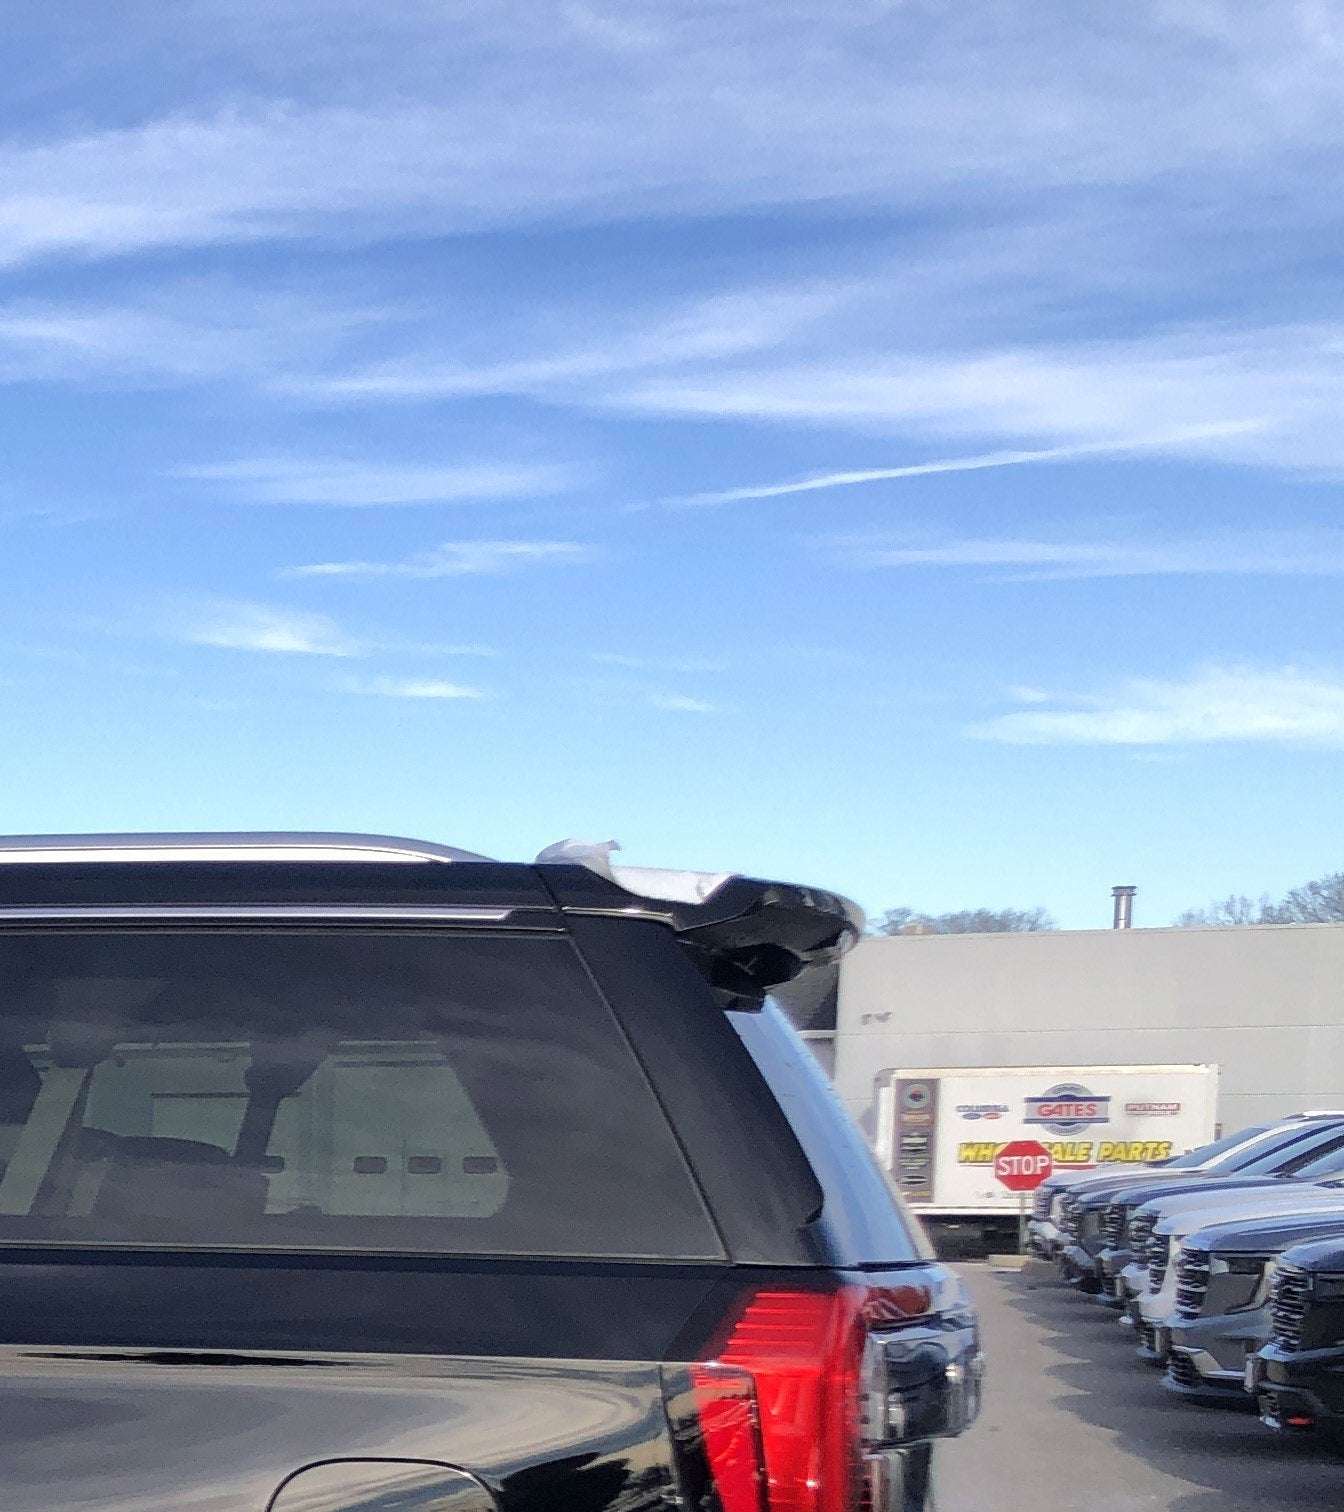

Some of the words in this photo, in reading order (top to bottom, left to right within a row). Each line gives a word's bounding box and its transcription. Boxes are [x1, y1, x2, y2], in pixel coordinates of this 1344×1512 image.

[1037, 1103, 1098, 1117] GATES
[958, 1141, 1093, 1164] WHALE
[1097, 1141, 1172, 1163] PARTS
[997, 1155, 1050, 1176] STOP
